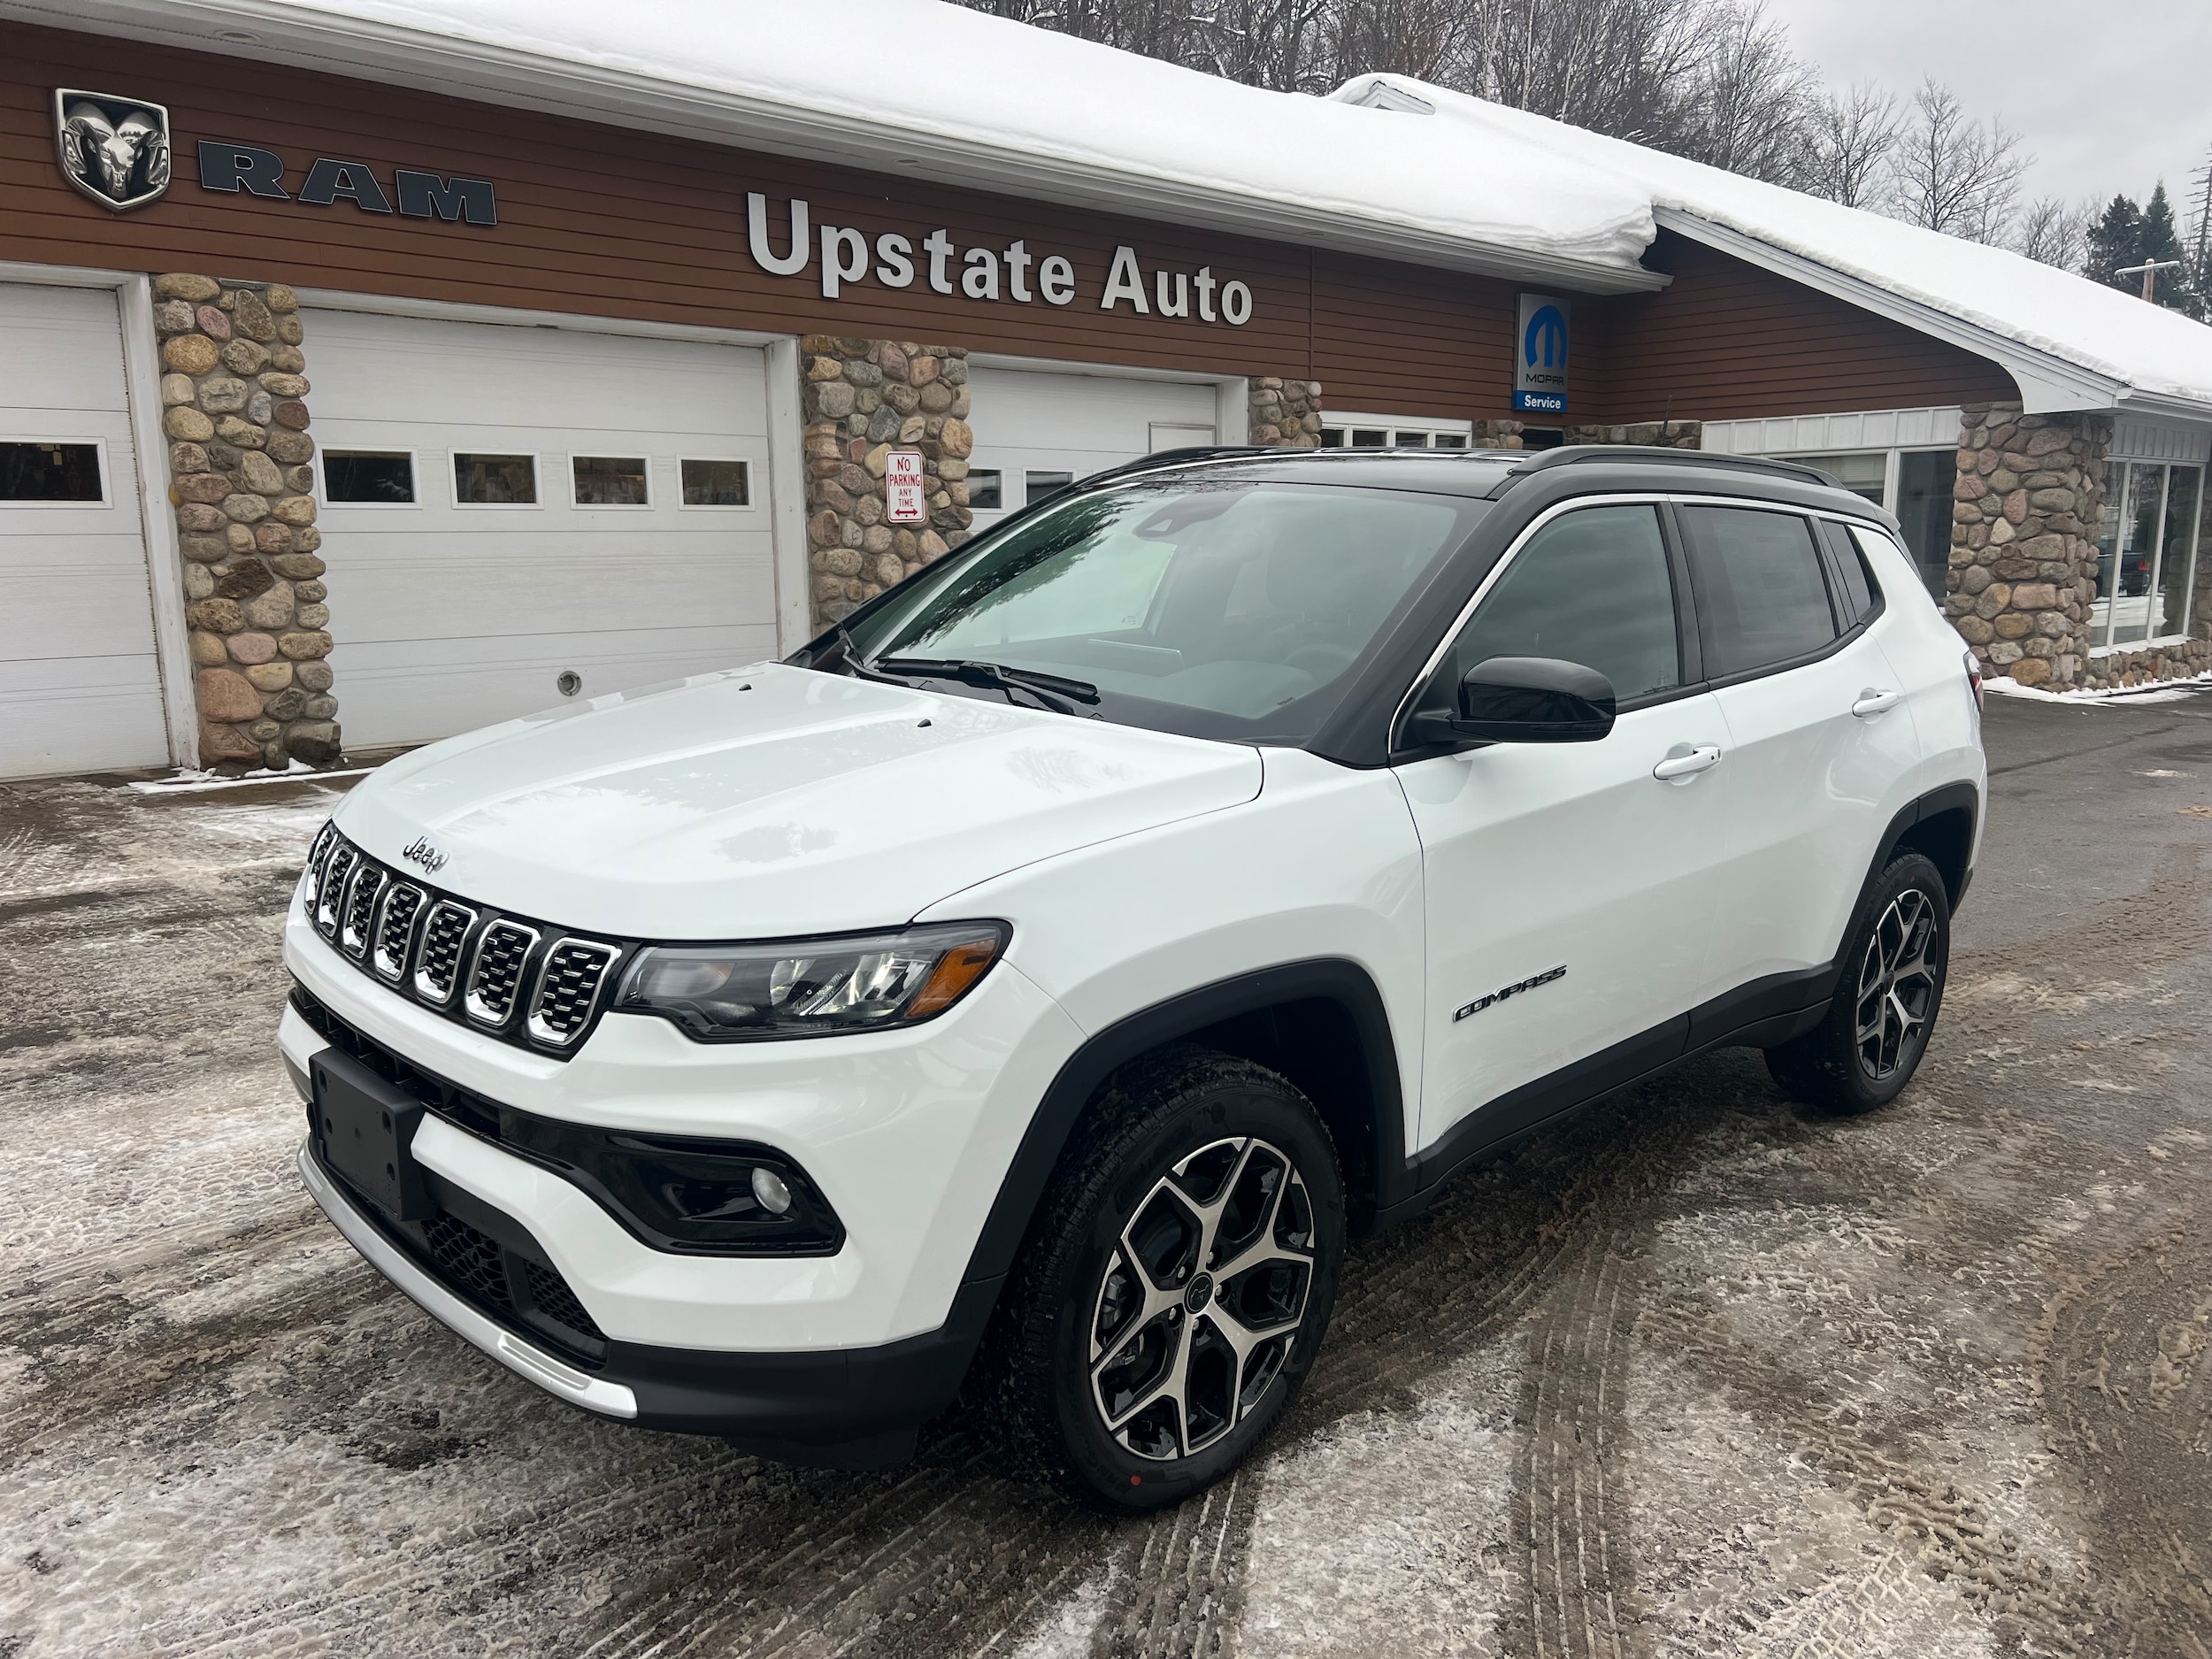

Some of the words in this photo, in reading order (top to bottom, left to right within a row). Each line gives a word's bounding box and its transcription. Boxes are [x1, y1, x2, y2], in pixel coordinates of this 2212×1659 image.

[197, 140, 498, 226] RAM
[746, 191, 1077, 300] Upstate
[1100, 244, 1254, 326] Auto
[1525, 373, 1564, 386] MOPAR
[1524, 394, 1562, 410] Service
[897, 458, 911, 472] NO
[889, 473, 921, 487] PARKING
[898, 488, 912, 497] ANY
[898, 498, 914, 507] TIME
[403, 835, 450, 876] Jeep
[1452, 963, 1567, 1023] COMPASS
